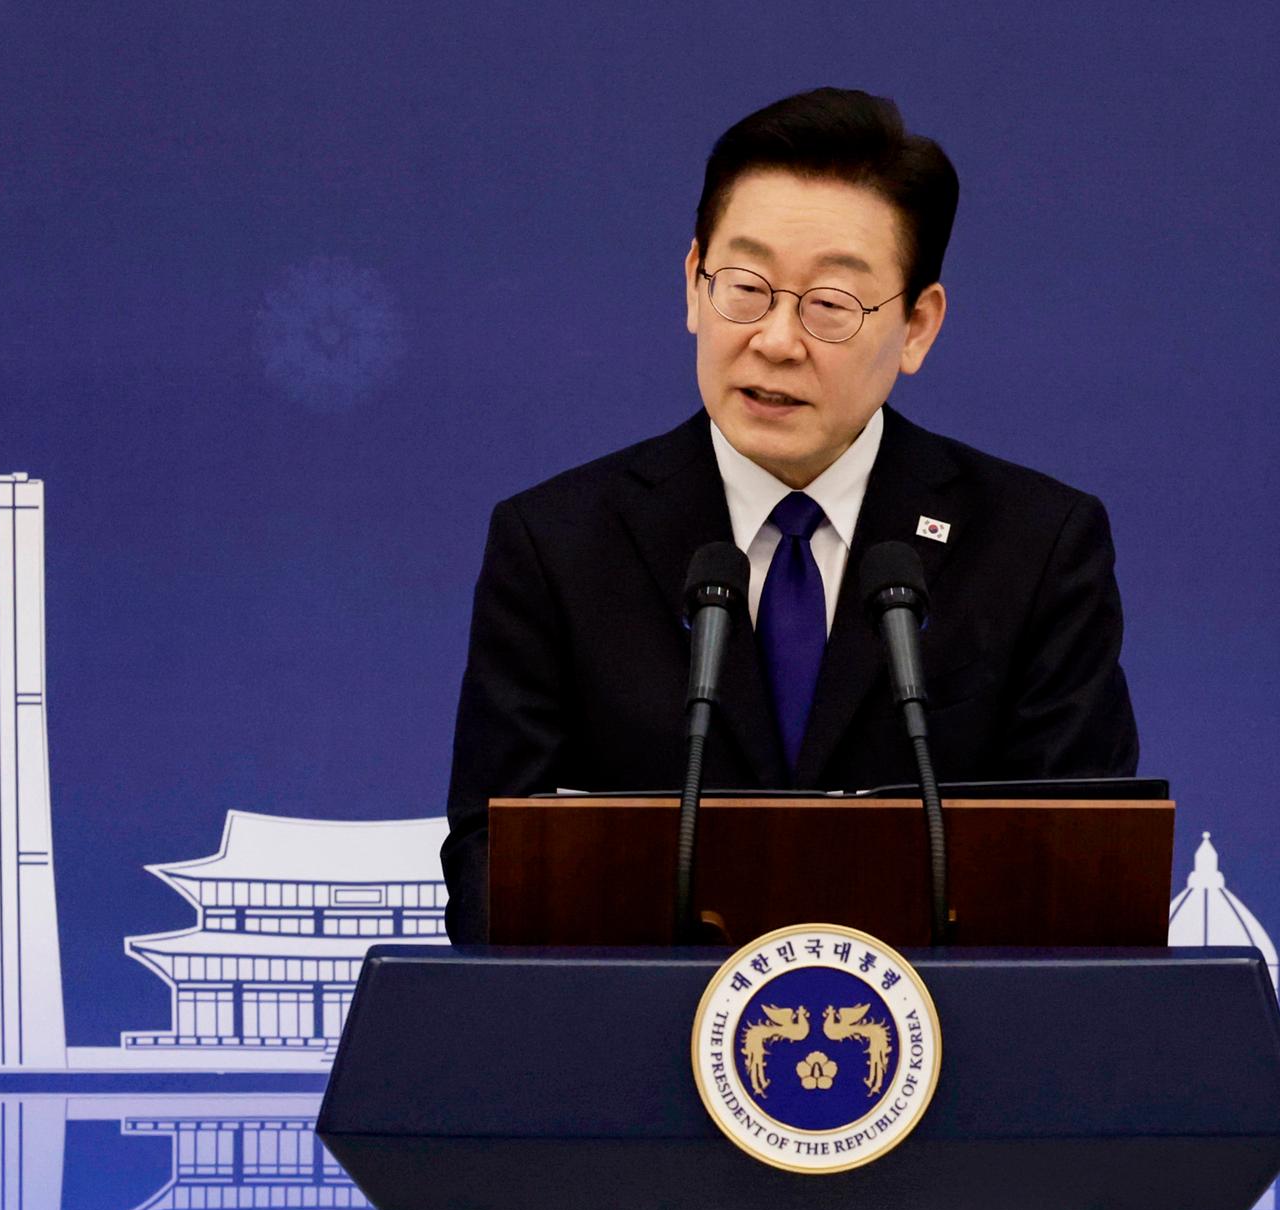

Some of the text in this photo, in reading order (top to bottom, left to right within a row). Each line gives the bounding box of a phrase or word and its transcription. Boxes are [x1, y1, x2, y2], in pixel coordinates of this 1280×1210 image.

[710, 1009, 924, 1156] THE PRESIDENT OF THE REPUBLIC OF KOREA
